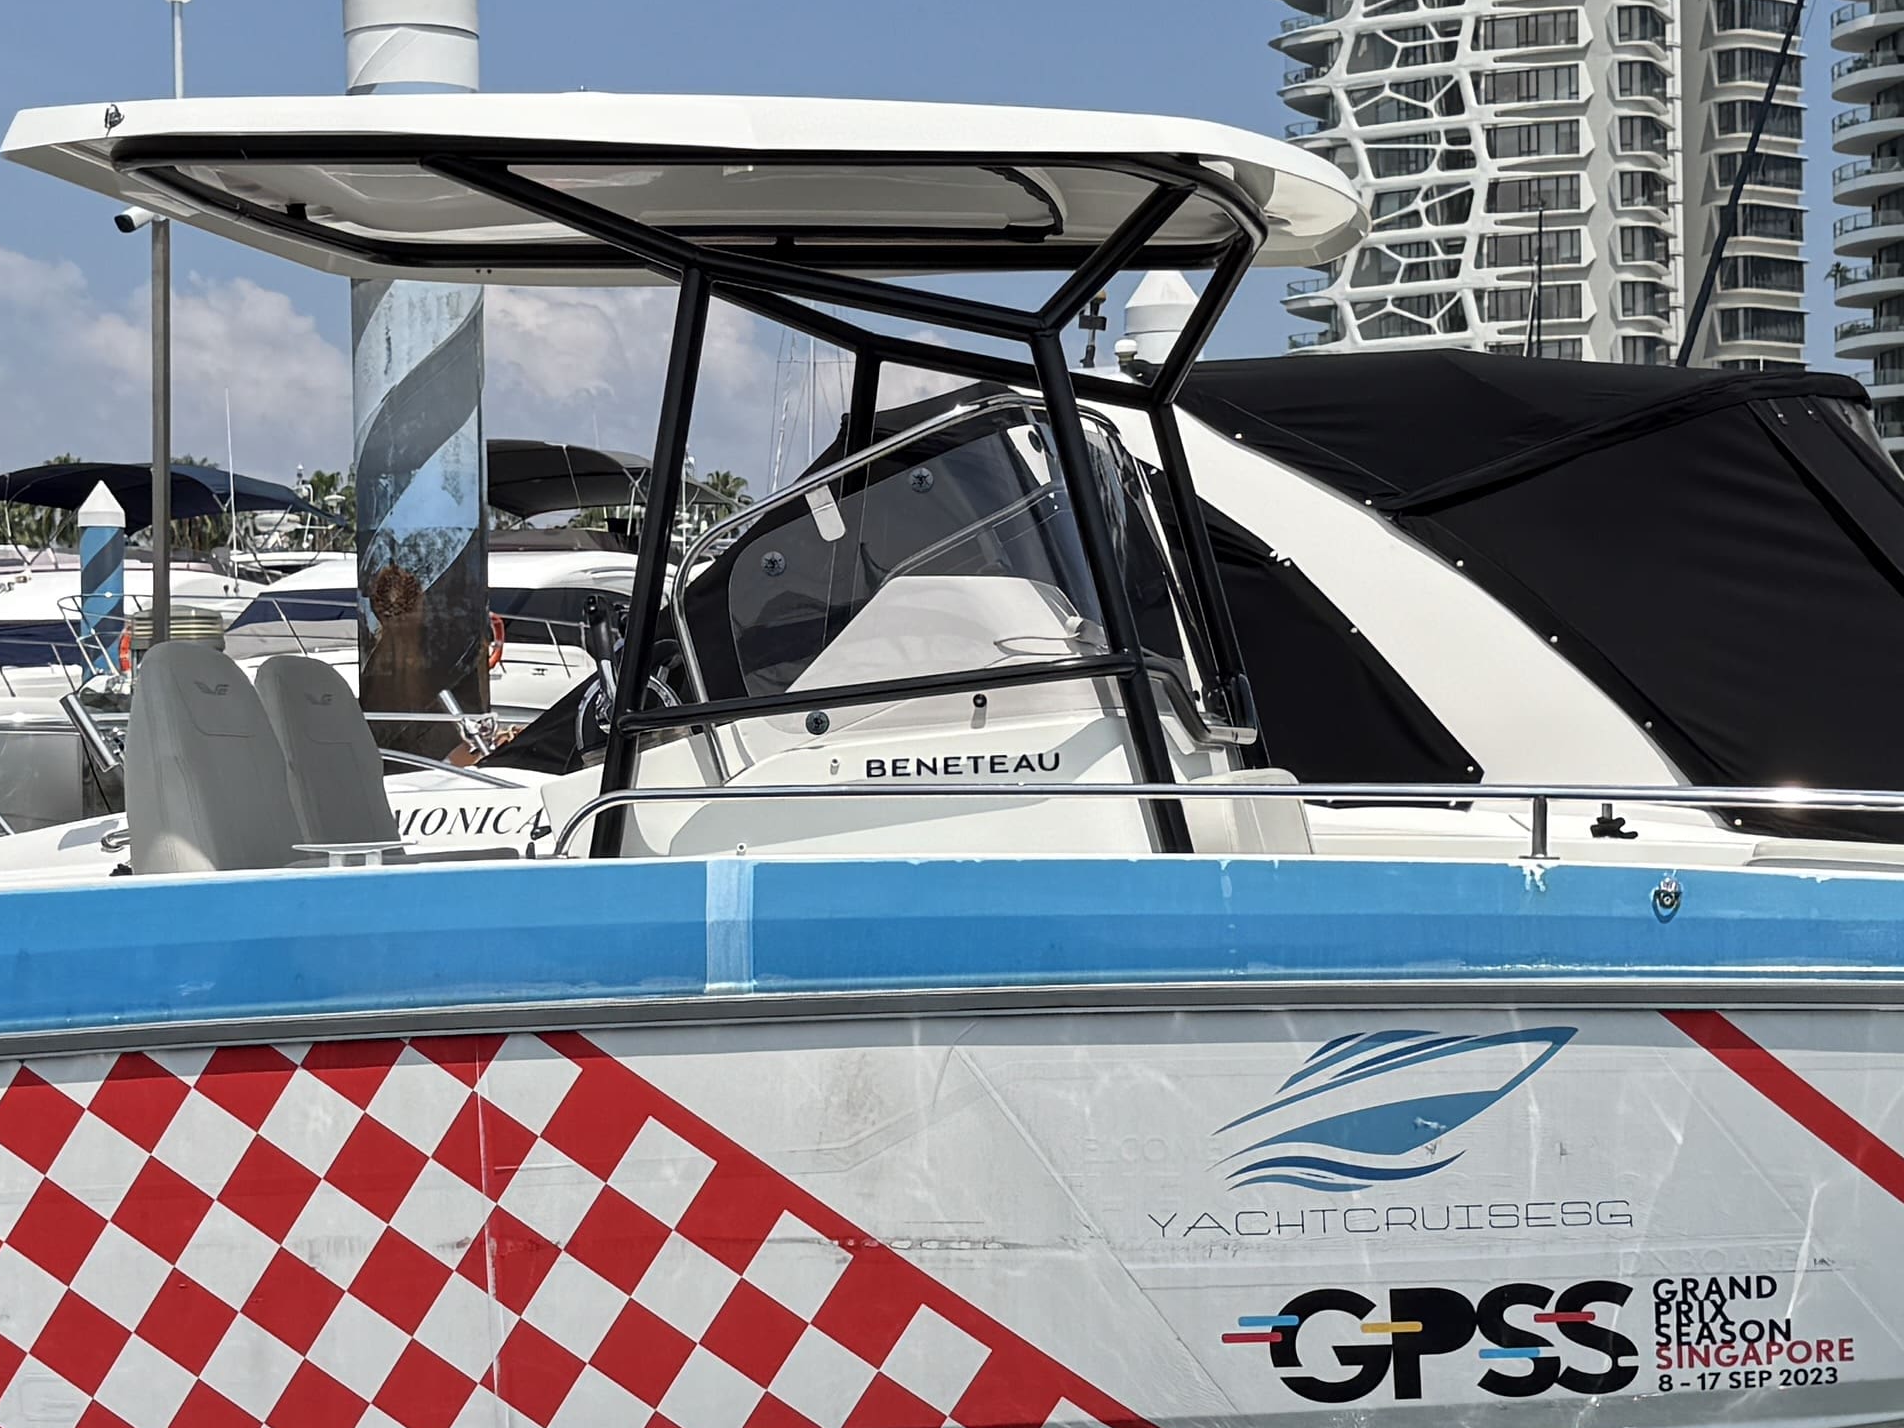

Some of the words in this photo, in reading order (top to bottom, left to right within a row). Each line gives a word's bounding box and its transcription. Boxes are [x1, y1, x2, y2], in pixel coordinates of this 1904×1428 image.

[865, 751, 1061, 779] BENETEAU
[1147, 1199, 1634, 1239] YACHTCRUISESG
[1652, 1274, 1778, 1303] GRAND
[1654, 1299, 1731, 1325] PRIX
[1269, 1279, 1640, 1404] GPSS
[1655, 1318, 1793, 1347] SEASON
[1655, 1337, 1855, 1371] SINGAPORE
[1657, 1373, 1674, 1393] 8
[1696, 1371, 1721, 1392] 17
[1728, 1370, 1773, 1390] SEP
[1779, 1366, 1839, 1387] 2023
